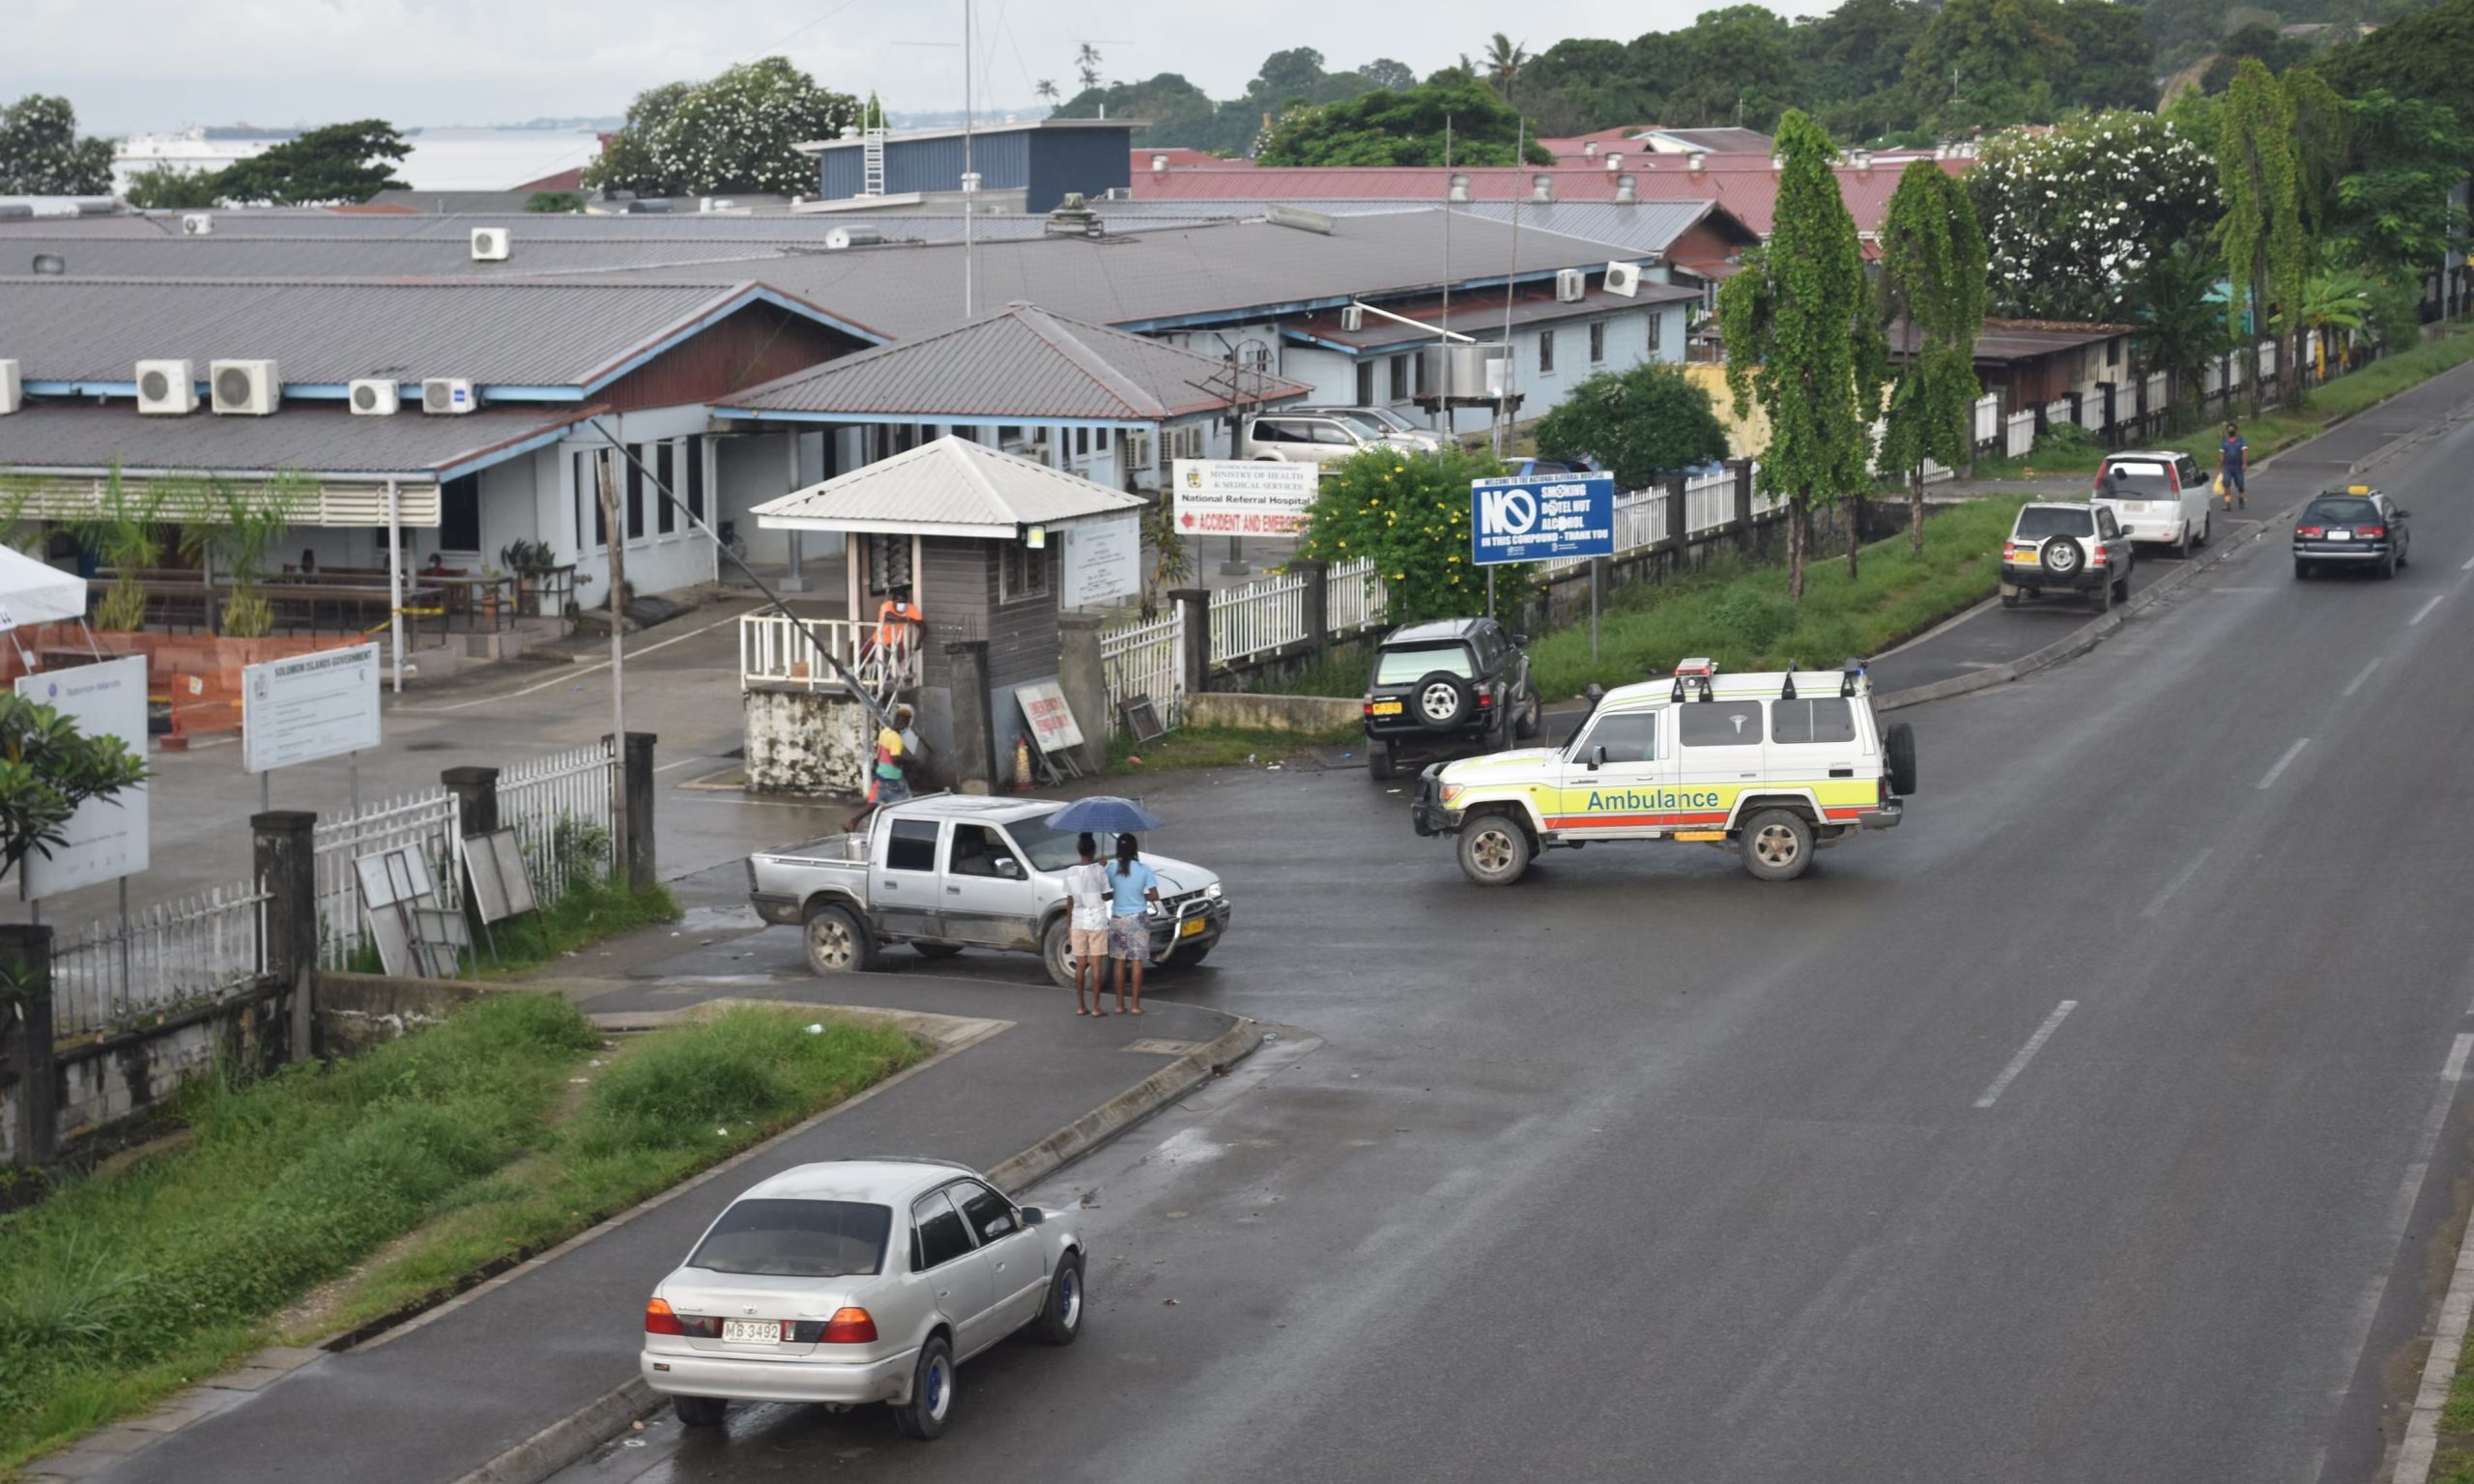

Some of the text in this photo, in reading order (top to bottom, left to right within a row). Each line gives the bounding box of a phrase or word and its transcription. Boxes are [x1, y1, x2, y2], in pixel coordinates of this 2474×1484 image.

[1268, 471, 1304, 480] HEALTH
[1555, 473, 1579, 482] REFERRAL
[1580, 471, 1604, 480] HOSPITAL
[1262, 482, 1303, 491] SERVICES
[1541, 484, 1587, 499] SMOKING
[1182, 494, 1310, 506] National Referral Hospital
[1572, 499, 1592, 512] NUT
[1481, 489, 1537, 534] NO
[1199, 513, 1241, 530] ACCIDENT
[1243, 514, 1260, 532] AND
[1541, 516, 1584, 531] ALCOHOL
[1482, 537, 1491, 547] IN
[1492, 536, 1511, 546] THIS
[1512, 532, 1558, 545] COMPOUND
[1564, 530, 1592, 541] THANK
[1593, 528, 1608, 539] YOU
[274, 663, 304, 677] SOLOMON
[305, 658, 331, 671] ISLANDS
[331, 649, 372, 667] GOVERNMENT
[1588, 789, 1718, 811] Ambulance
